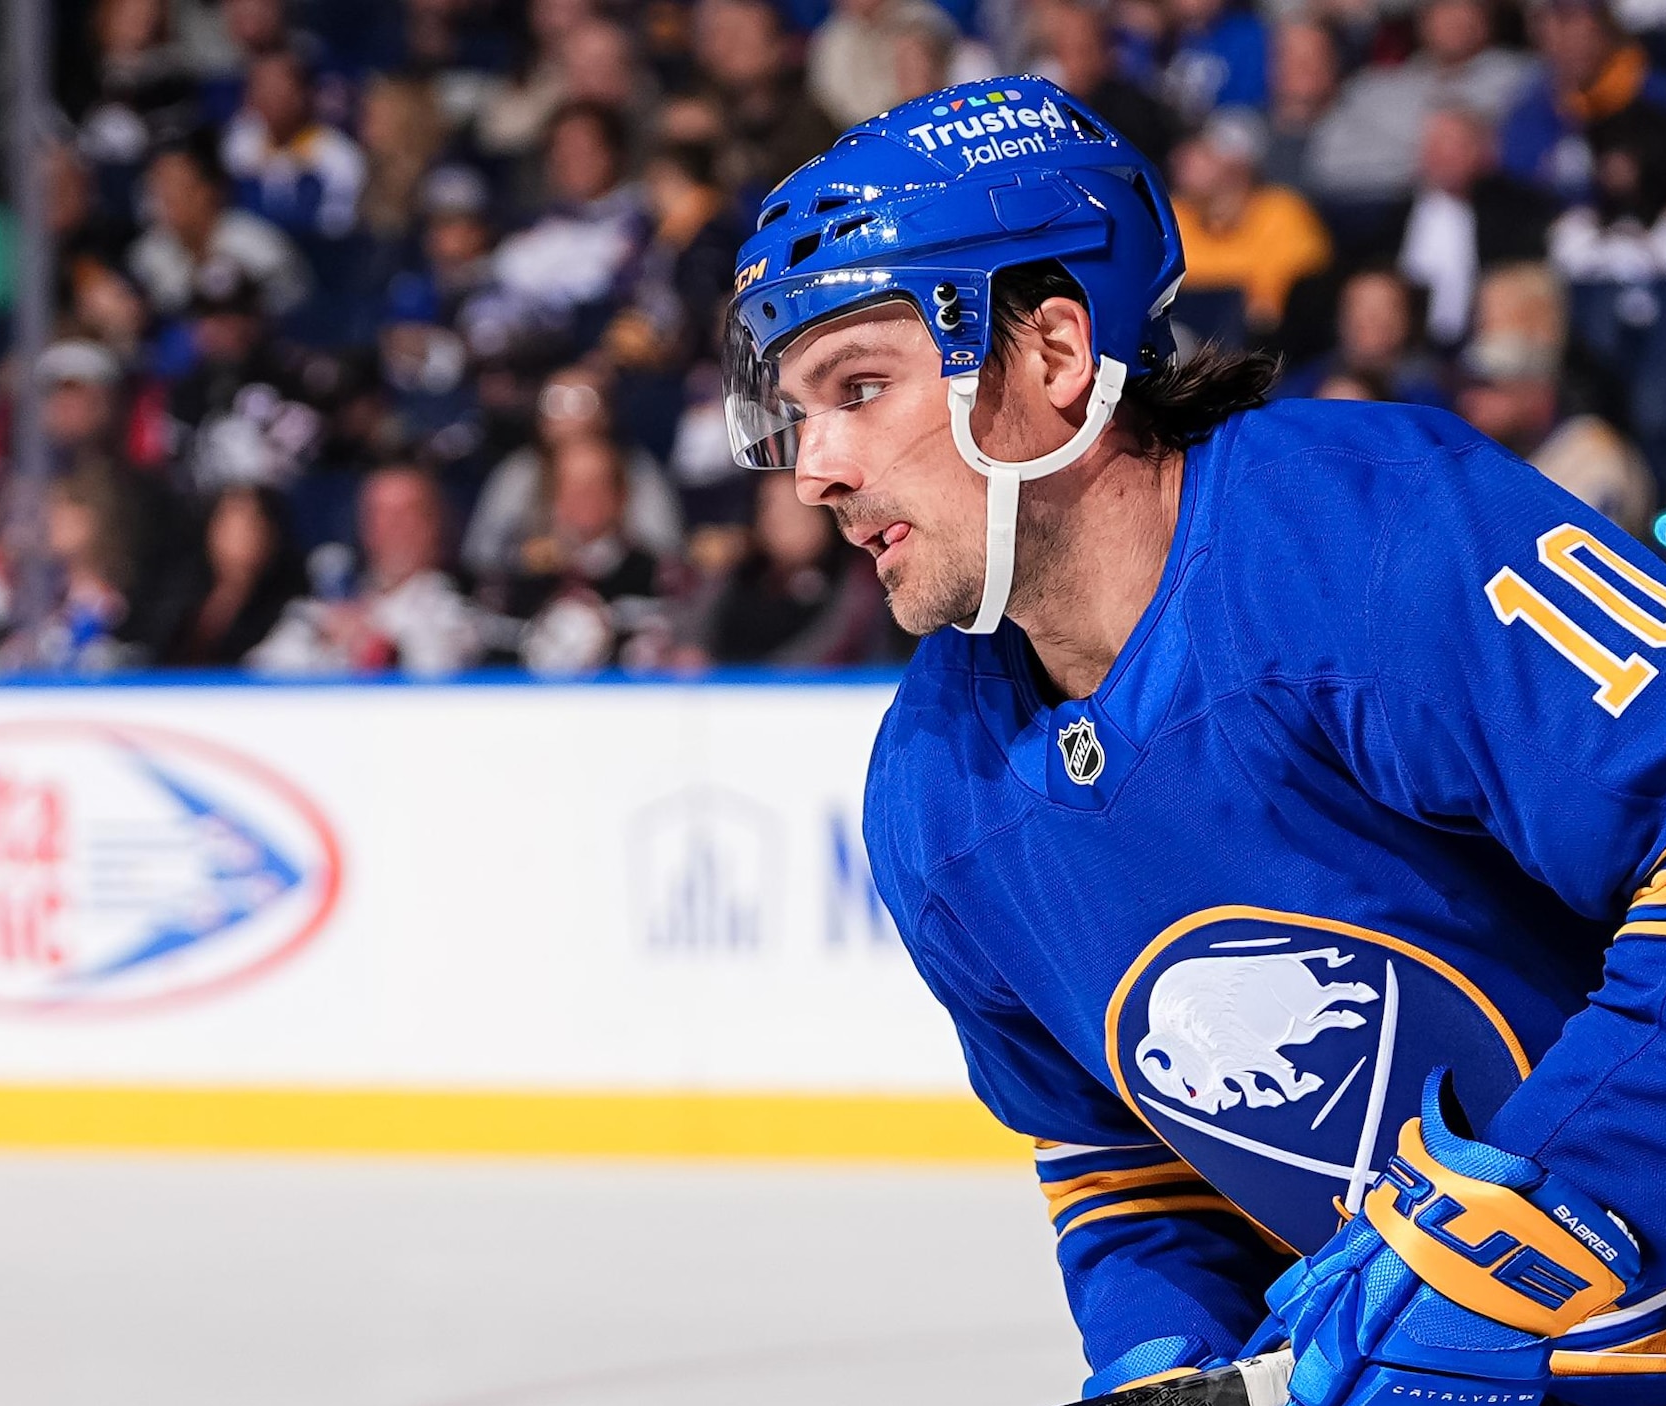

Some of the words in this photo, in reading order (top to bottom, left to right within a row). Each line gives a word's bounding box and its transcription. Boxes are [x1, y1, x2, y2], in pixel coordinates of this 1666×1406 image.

[908, 100, 1067, 152] Trusted
[961, 131, 1047, 169] talent
[735, 257, 768, 293] CM
[944, 359, 981, 367] OAKLEY
[1372, 1154, 1594, 1313] RUE
[1552, 1203, 1619, 1262] SABRES
[1391, 1385, 1512, 1403] CATALYST
